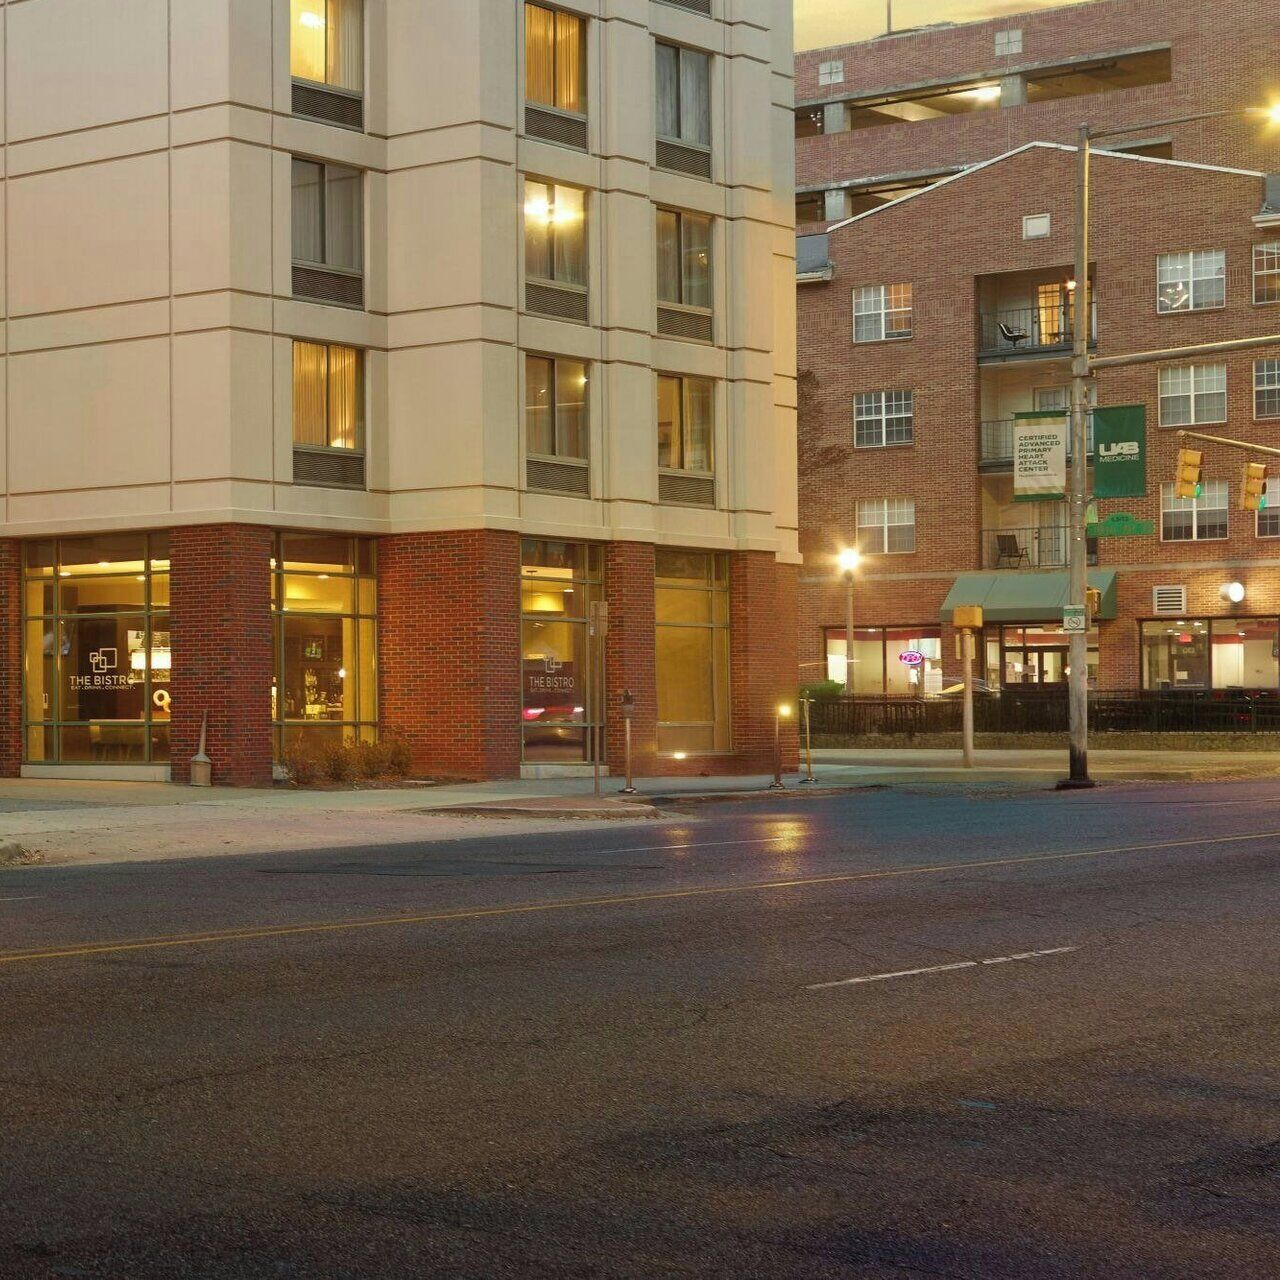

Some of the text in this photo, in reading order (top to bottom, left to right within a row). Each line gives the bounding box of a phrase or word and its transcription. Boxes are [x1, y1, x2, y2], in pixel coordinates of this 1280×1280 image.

[1099, 441, 1139, 456] UAB
[1099, 454, 1140, 463] MEDICINE
[69, 675, 135, 685] THE BISTRO
[529, 676, 575, 688] THE BISTRO
